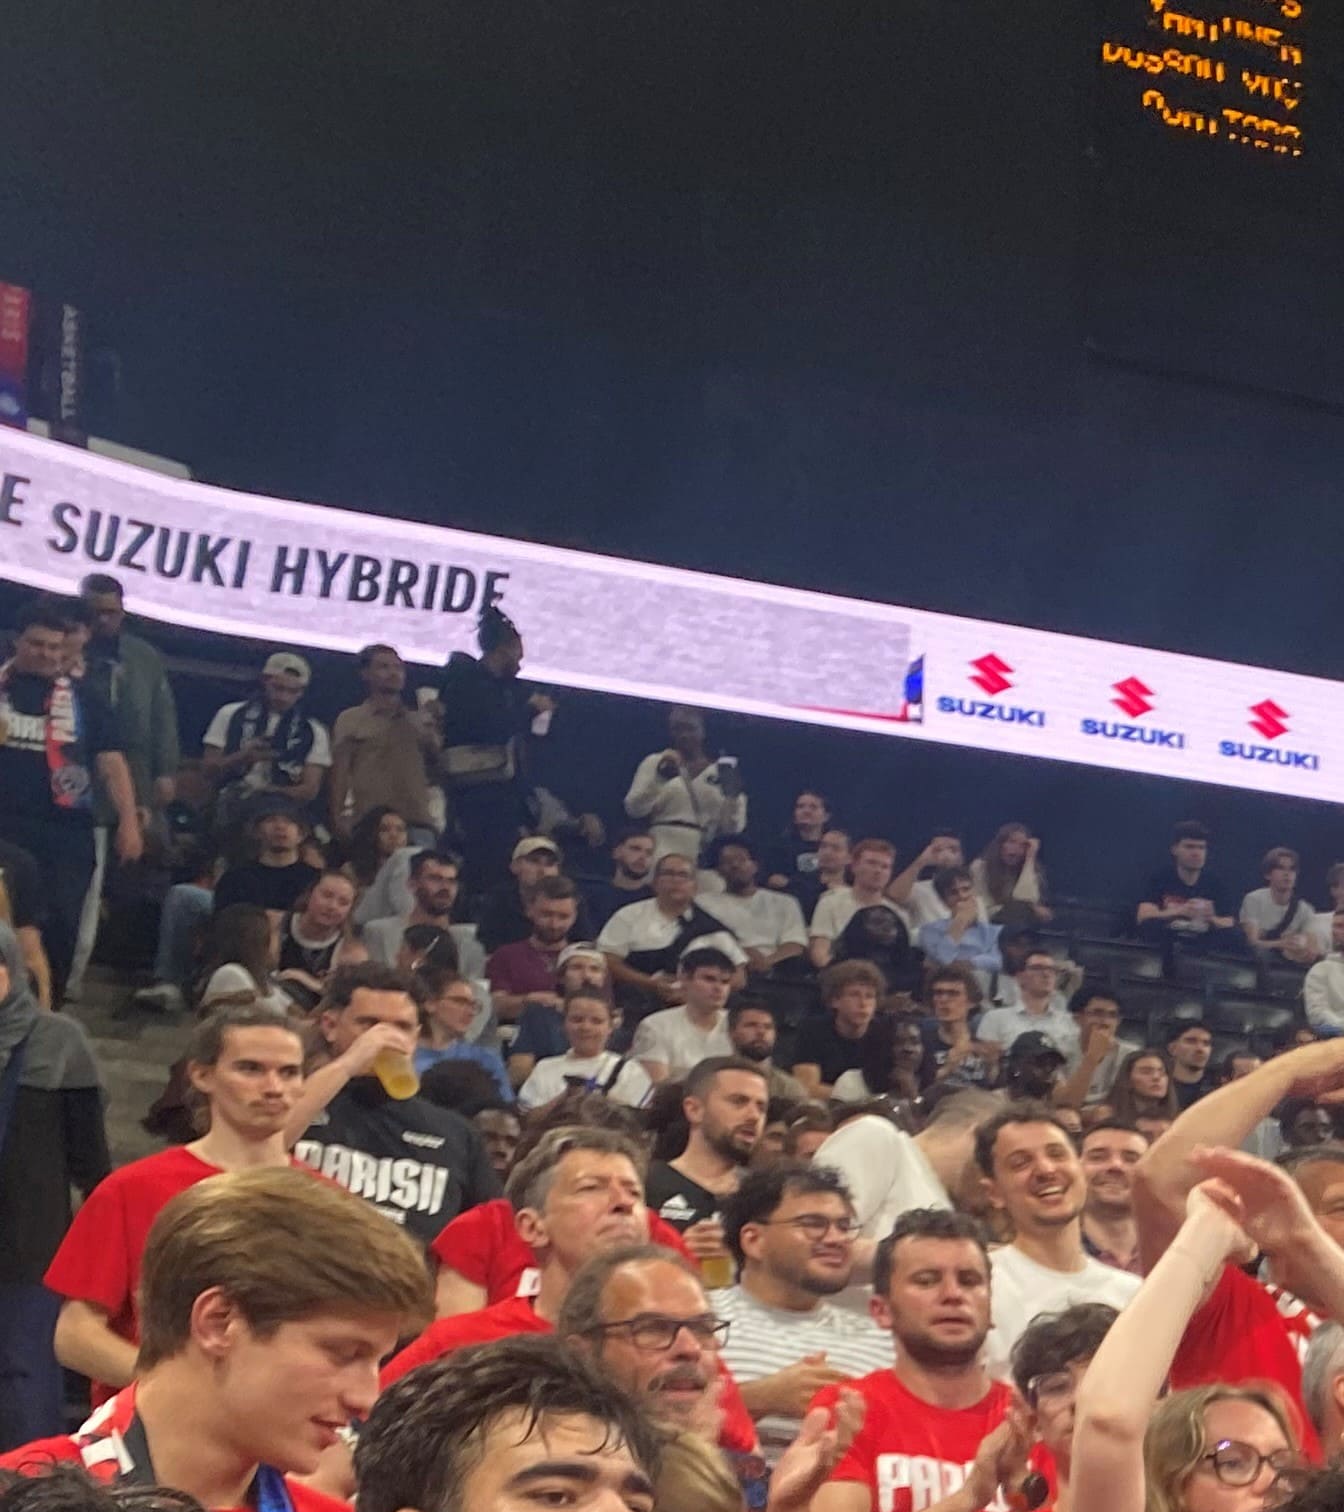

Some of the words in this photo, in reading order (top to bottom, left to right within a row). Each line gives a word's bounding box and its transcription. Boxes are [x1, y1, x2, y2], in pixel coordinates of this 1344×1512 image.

[46, 502, 253, 590] SUZUKI
[269, 545, 511, 614] HYBRIDE
[937, 695, 1045, 729] SUZUKI
[1080, 718, 1185, 750] SUZUKI
[1218, 740, 1319, 771] SUZUKI
